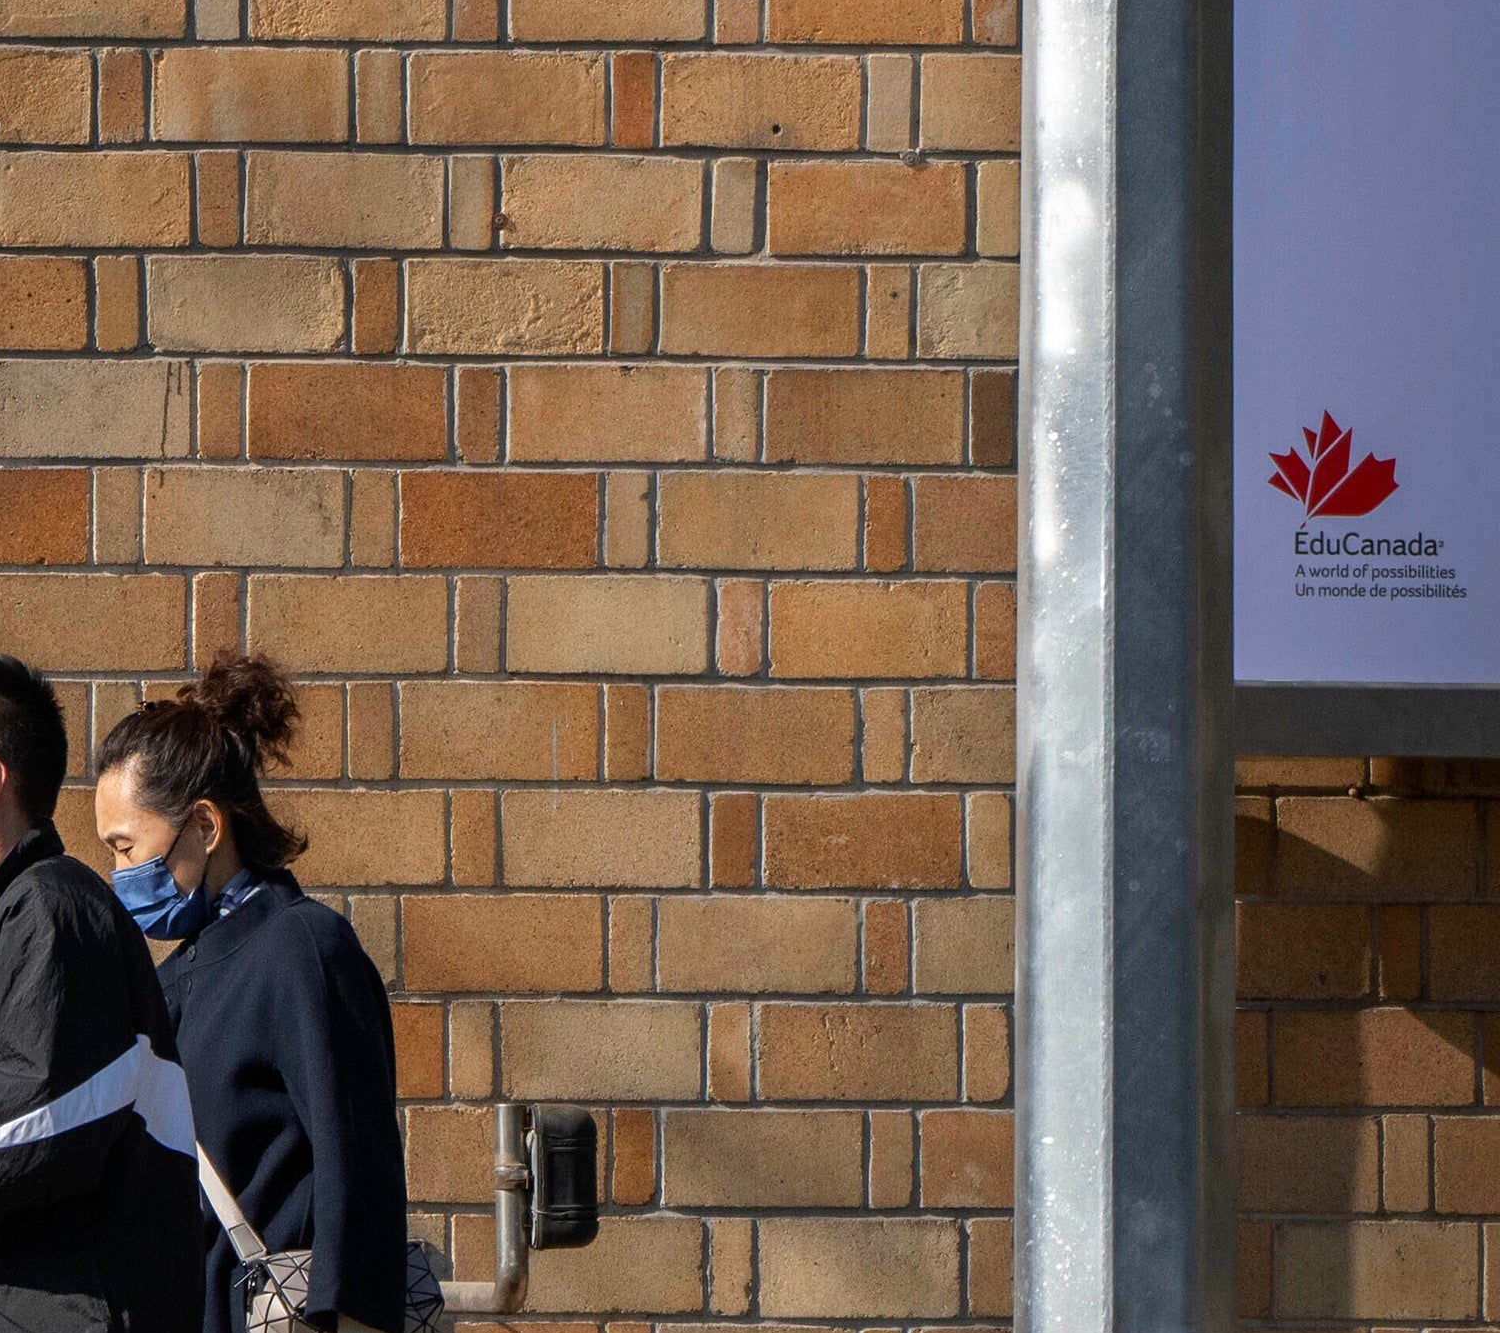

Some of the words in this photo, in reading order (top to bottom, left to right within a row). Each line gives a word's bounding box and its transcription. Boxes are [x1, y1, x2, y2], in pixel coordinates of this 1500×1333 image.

[1295, 564, 1306, 578] A
[1309, 564, 1350, 579] world
[1353, 564, 1370, 579] of
[1371, 564, 1456, 581] possibilities
[1295, 583, 1315, 597] Un
[1318, 584, 1366, 598] monde
[1369, 584, 1387, 598] de
[1390, 584, 1468, 601] possibilités
